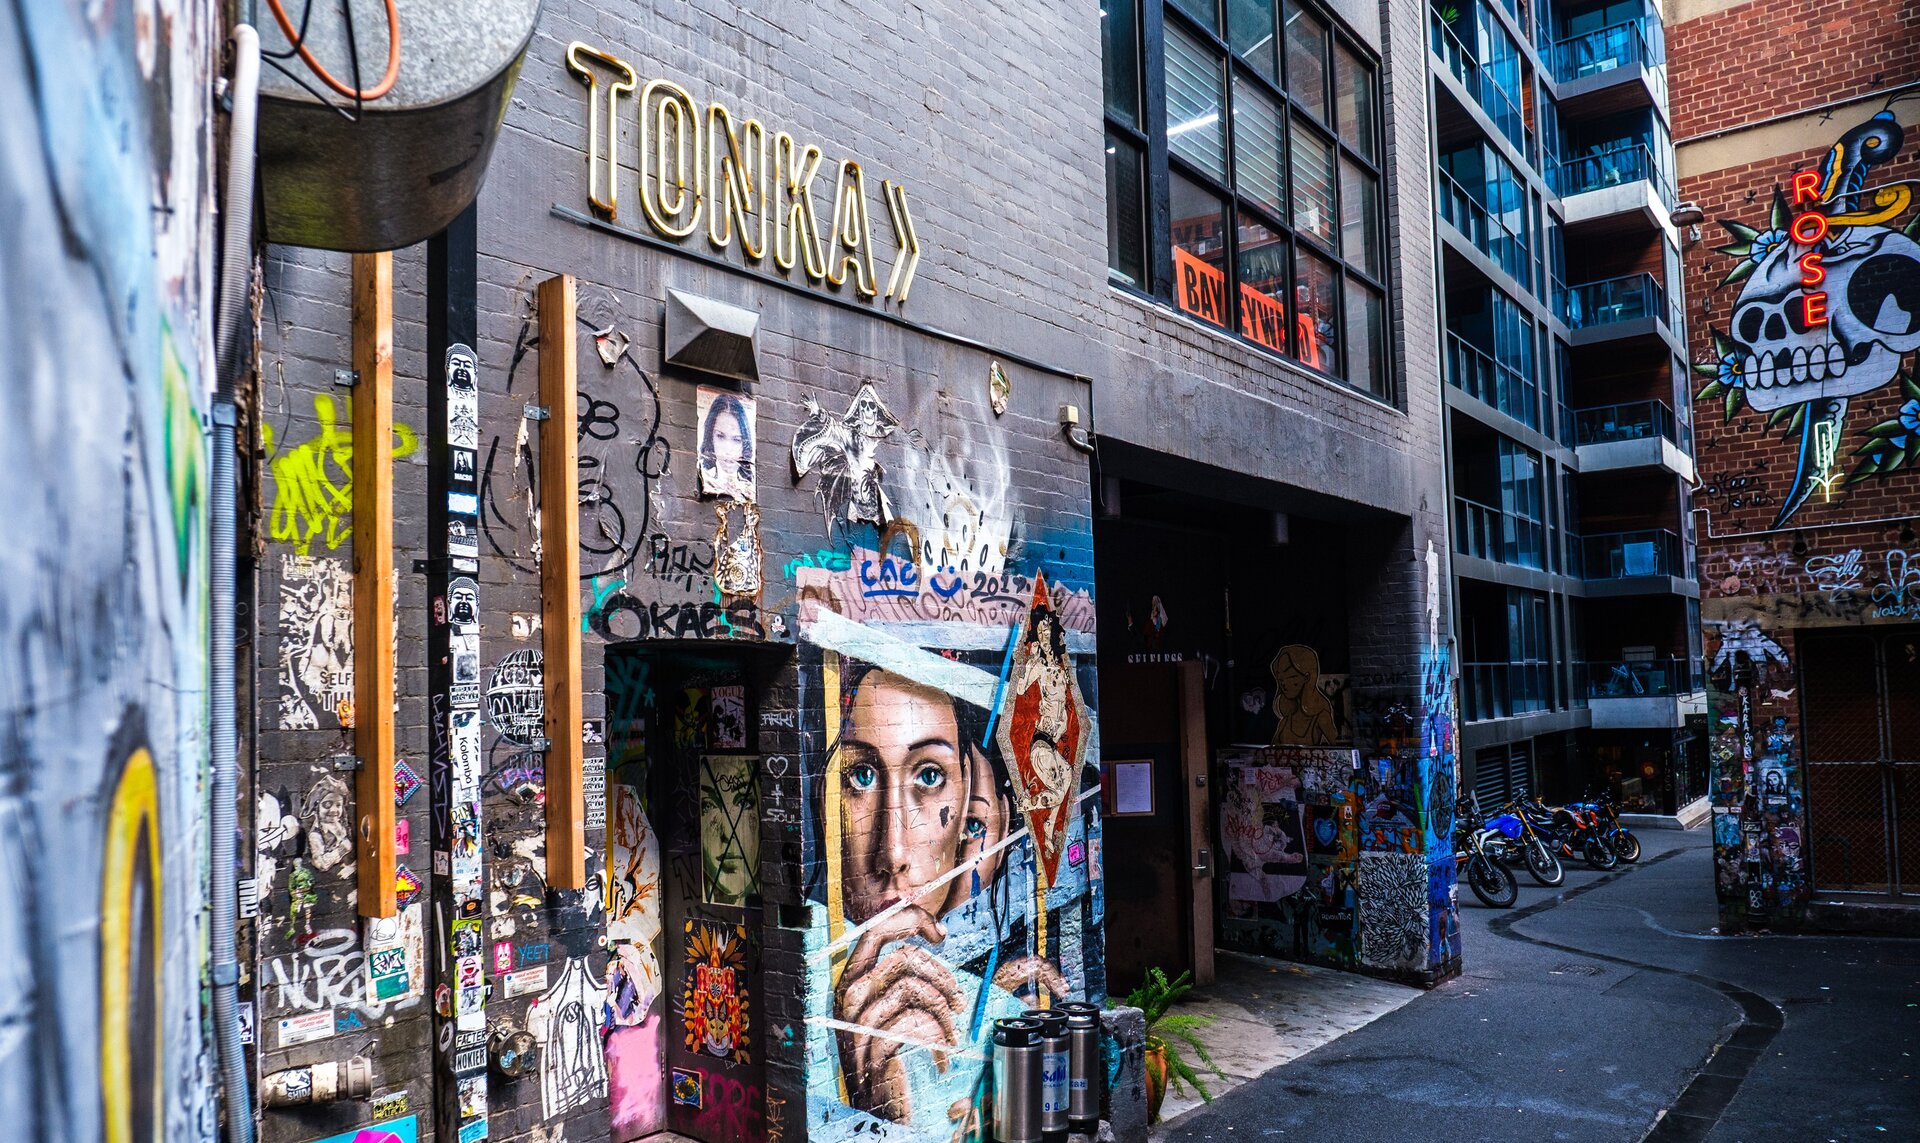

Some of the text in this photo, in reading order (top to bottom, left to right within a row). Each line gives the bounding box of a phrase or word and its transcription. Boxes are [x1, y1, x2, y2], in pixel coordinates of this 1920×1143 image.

[566, 40, 878, 298] TONKA
[1790, 170, 1829, 328] ROSE
[712, 687, 746, 699] VOGUE
[458, 736, 472, 784] Kolombo
[766, 808, 802, 824] SOUL
[517, 943, 550, 968] YEET
[1042, 1064, 1067, 1083] sahi
